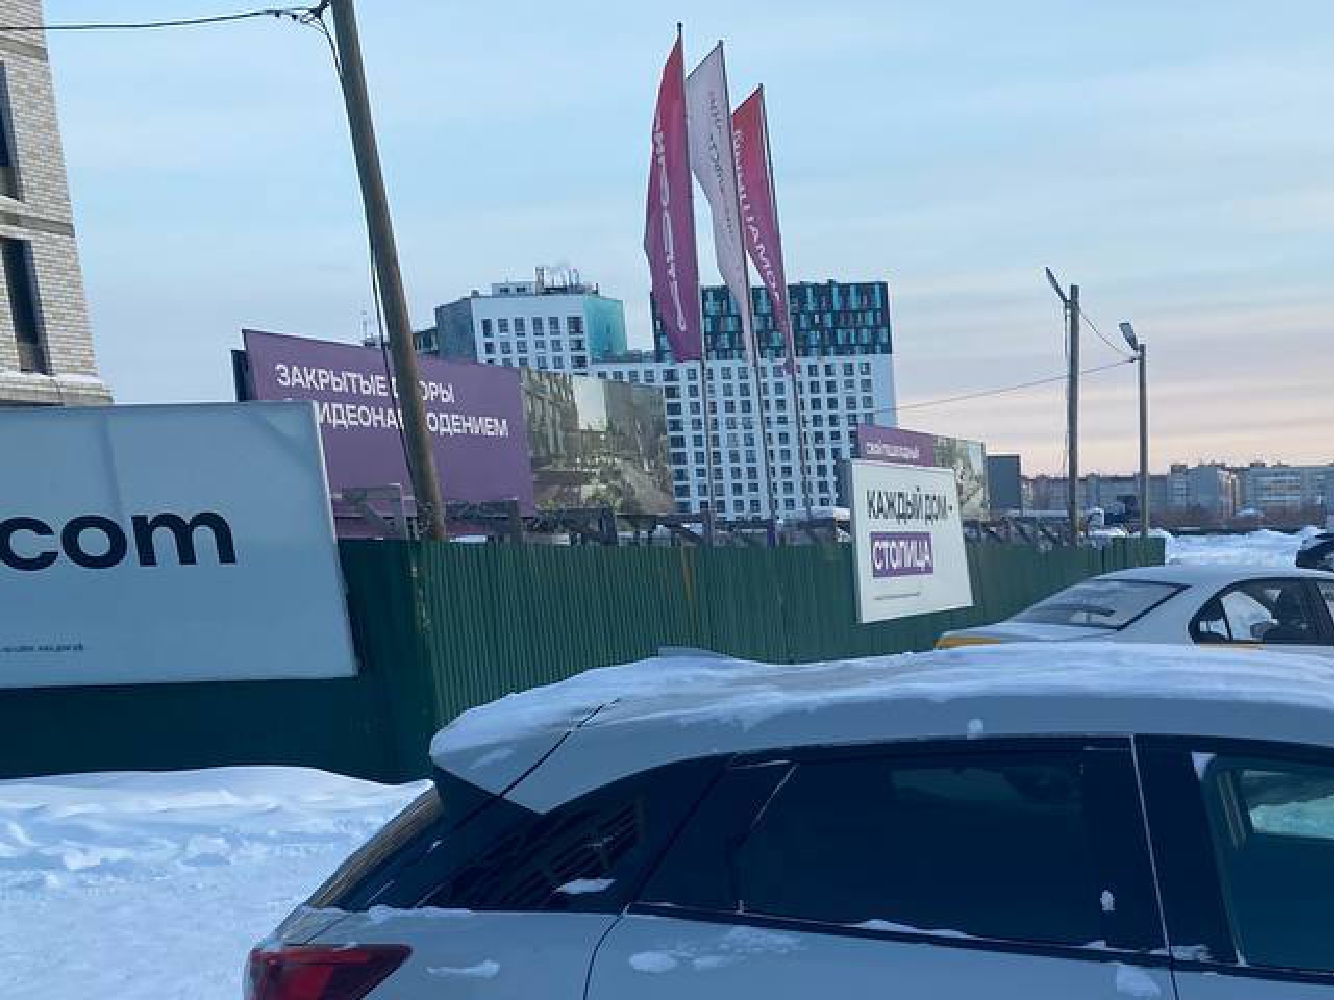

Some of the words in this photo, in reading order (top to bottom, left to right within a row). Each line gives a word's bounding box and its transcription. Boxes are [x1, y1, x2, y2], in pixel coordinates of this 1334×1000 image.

[275, 365, 388, 397] ЗАКРЫТЫЕ
[866, 485, 922, 525] КАЖДЫЙ
[924, 494, 947, 526] ДОМ
[873, 541, 931, 572] СТОЛИЦА
